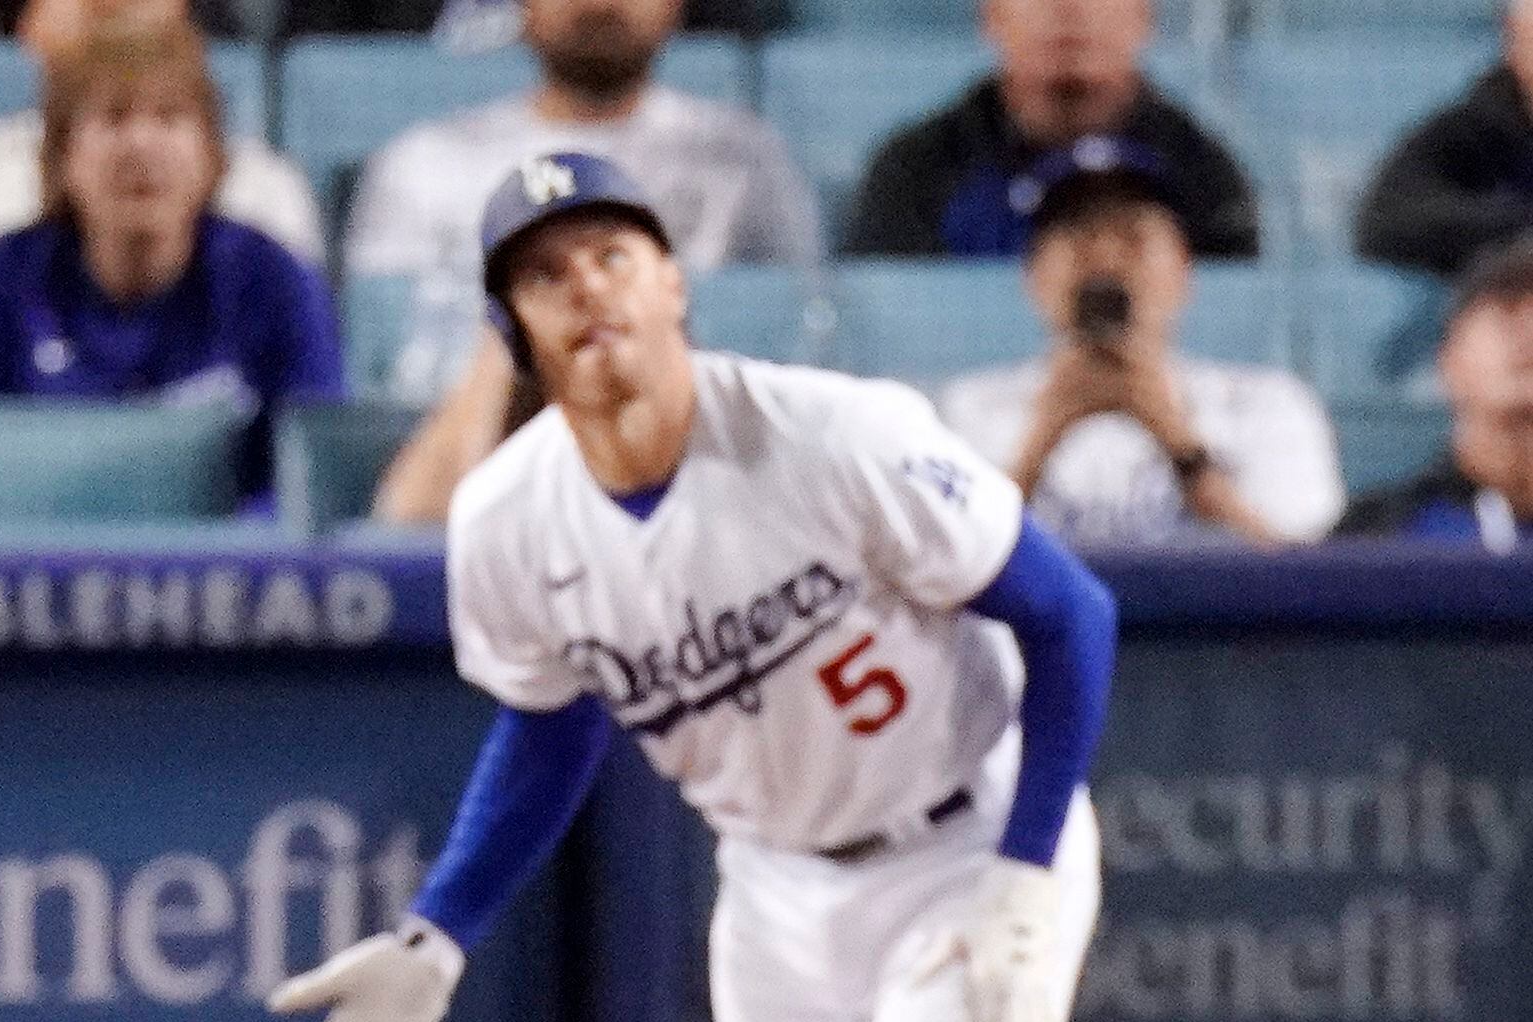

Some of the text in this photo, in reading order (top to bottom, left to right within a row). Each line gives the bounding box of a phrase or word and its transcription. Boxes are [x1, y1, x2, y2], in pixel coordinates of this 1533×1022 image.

[561, 558, 860, 716] Dodgers
[818, 632, 908, 736] 5
[1100, 740, 1531, 935] ecurity
[1080, 893, 1465, 1018] enefit
